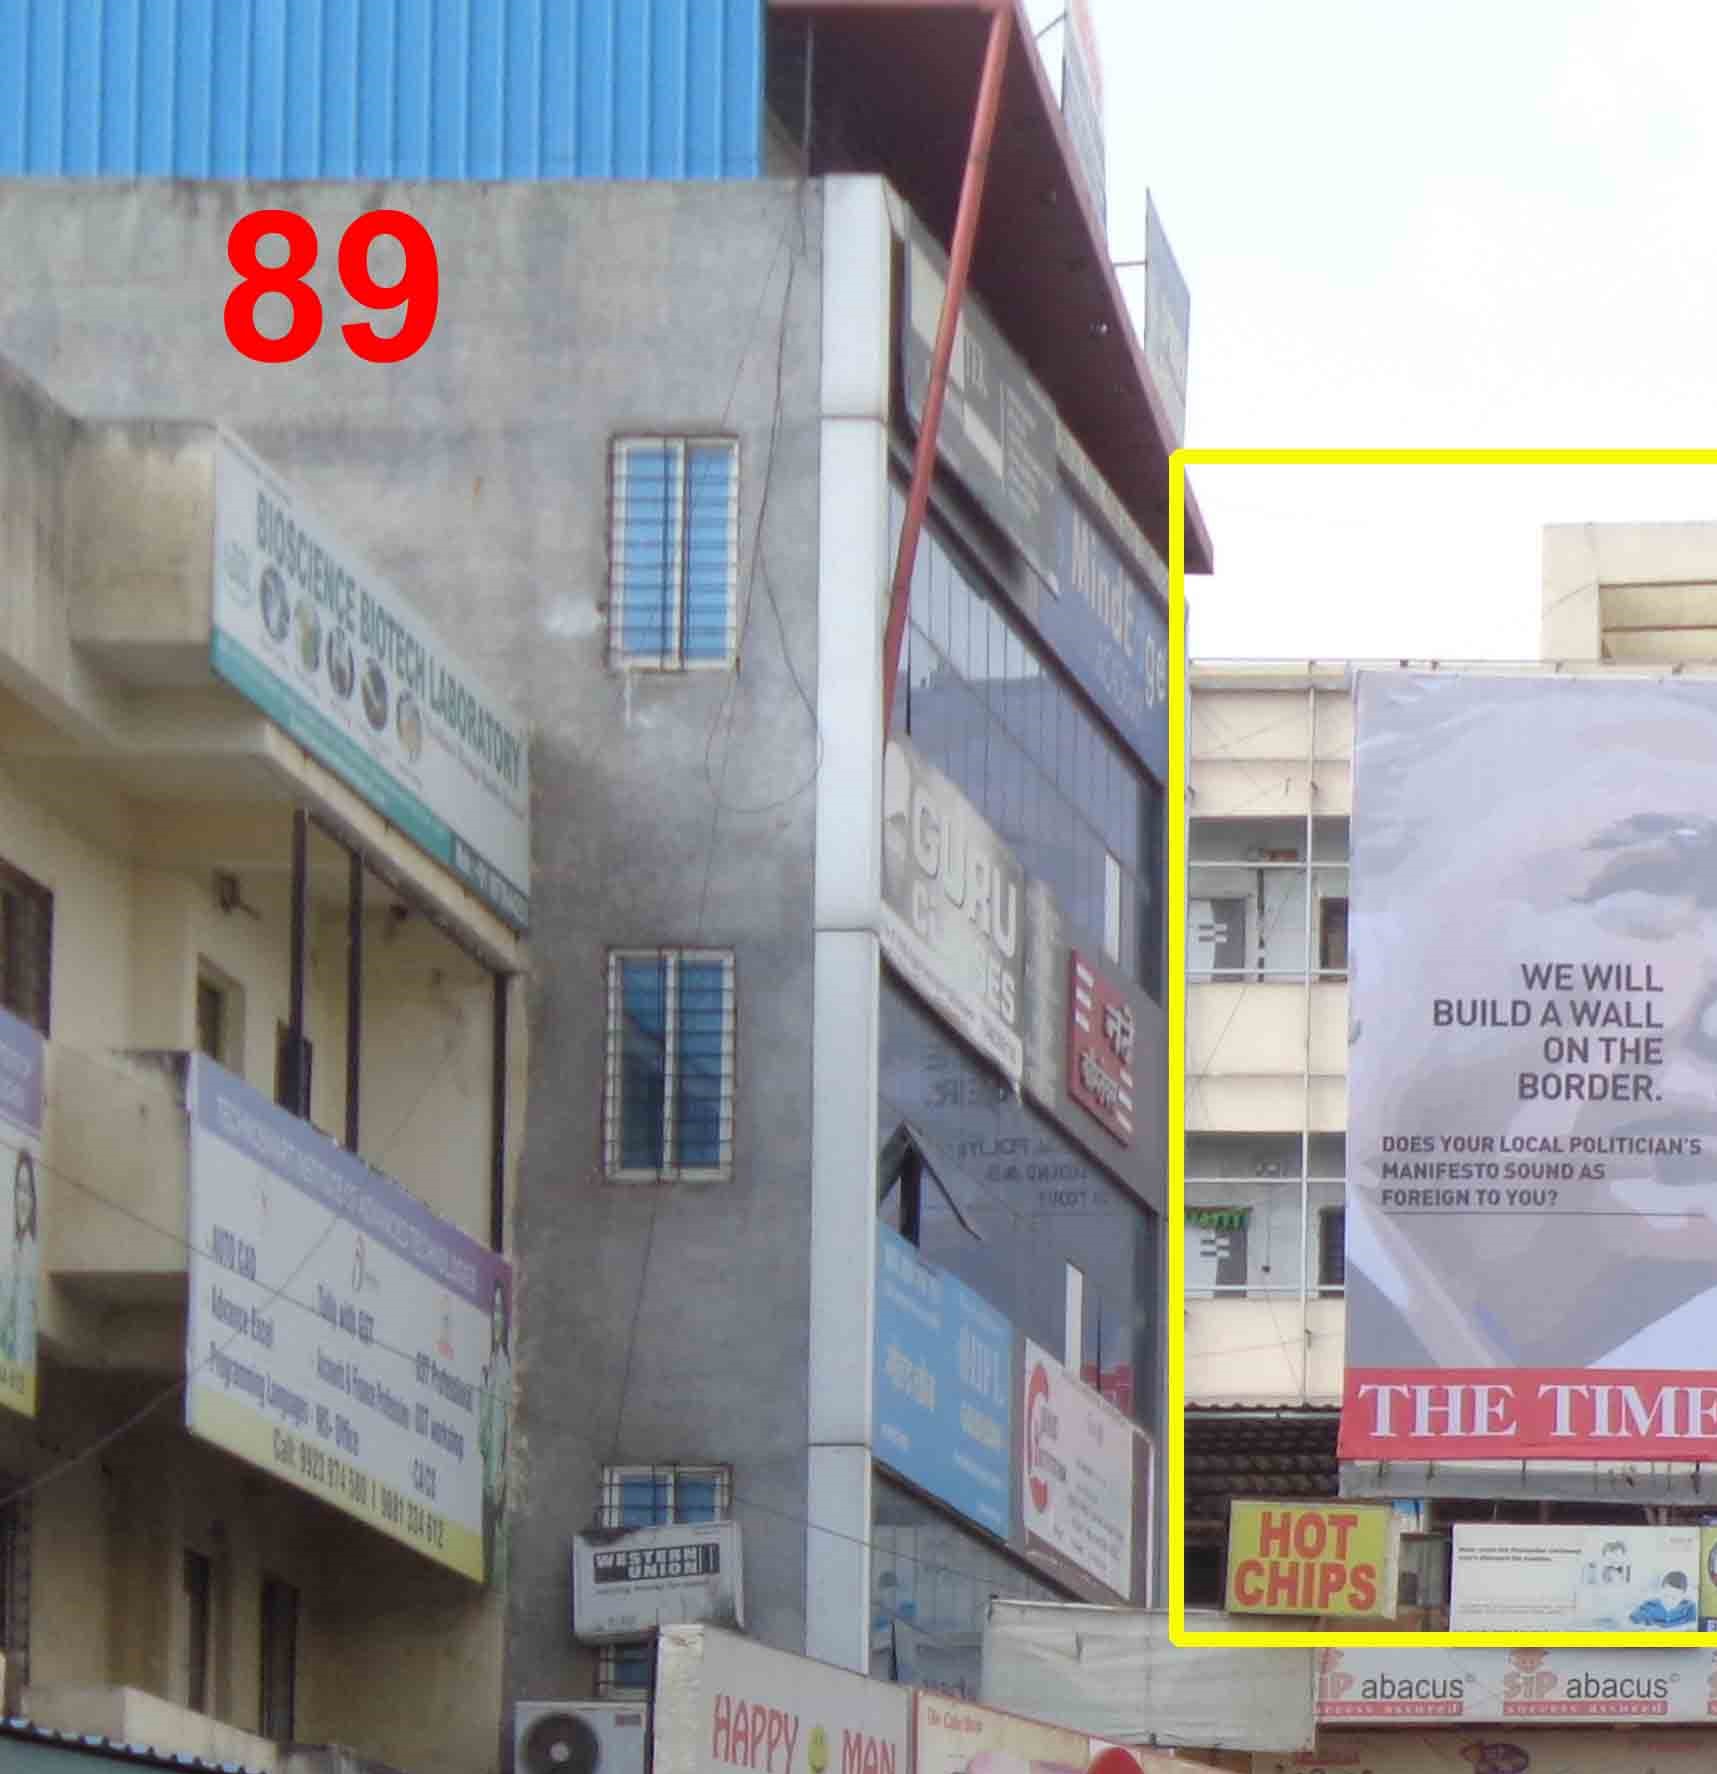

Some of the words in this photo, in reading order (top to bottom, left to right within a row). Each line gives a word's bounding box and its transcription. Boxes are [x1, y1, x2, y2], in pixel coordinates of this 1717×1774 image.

[256, 493, 356, 635] BIOSCIENCE
[359, 588, 426, 690] BIOTECH
[428, 657, 520, 789] LABORATORY
[1521, 964, 1574, 993] WE
[1583, 964, 1664, 993] WILL
[1434, 1000, 1532, 1029] BUILD
[1541, 1000, 1562, 1029] A
[1571, 1000, 1664, 1029] WALL
[1543, 1037, 1590, 1065] ON
[1599, 1037, 1664, 1065] THE
[1519, 1073, 1663, 1102] BORDER.
[1382, 1136, 1432, 1154] DOES
[1437, 1136, 1496, 1154] YOUR
[1500, 1136, 1563, 1154] LOCAL
[1570, 1136, 1702, 1157] POLITICIAN'S
[1382, 1162, 1499, 1181] MANIFESTO
[1504, 1162, 1573, 1181] SOUND
[1579, 1162, 1605, 1181] AS
[1382, 1189, 1469, 1208] FOREIGN
[1476, 1189, 1501, 1208] TO
[1504, 1189, 1559, 1208] YOU?
[1357, 1385, 1517, 1438] THE
[1258, 1513, 1355, 1559] HOT
[595, 1544, 701, 1569] WESTERN
[627, 1559, 701, 1579] UNION
[1234, 1561, 1376, 1610] CHIPS
